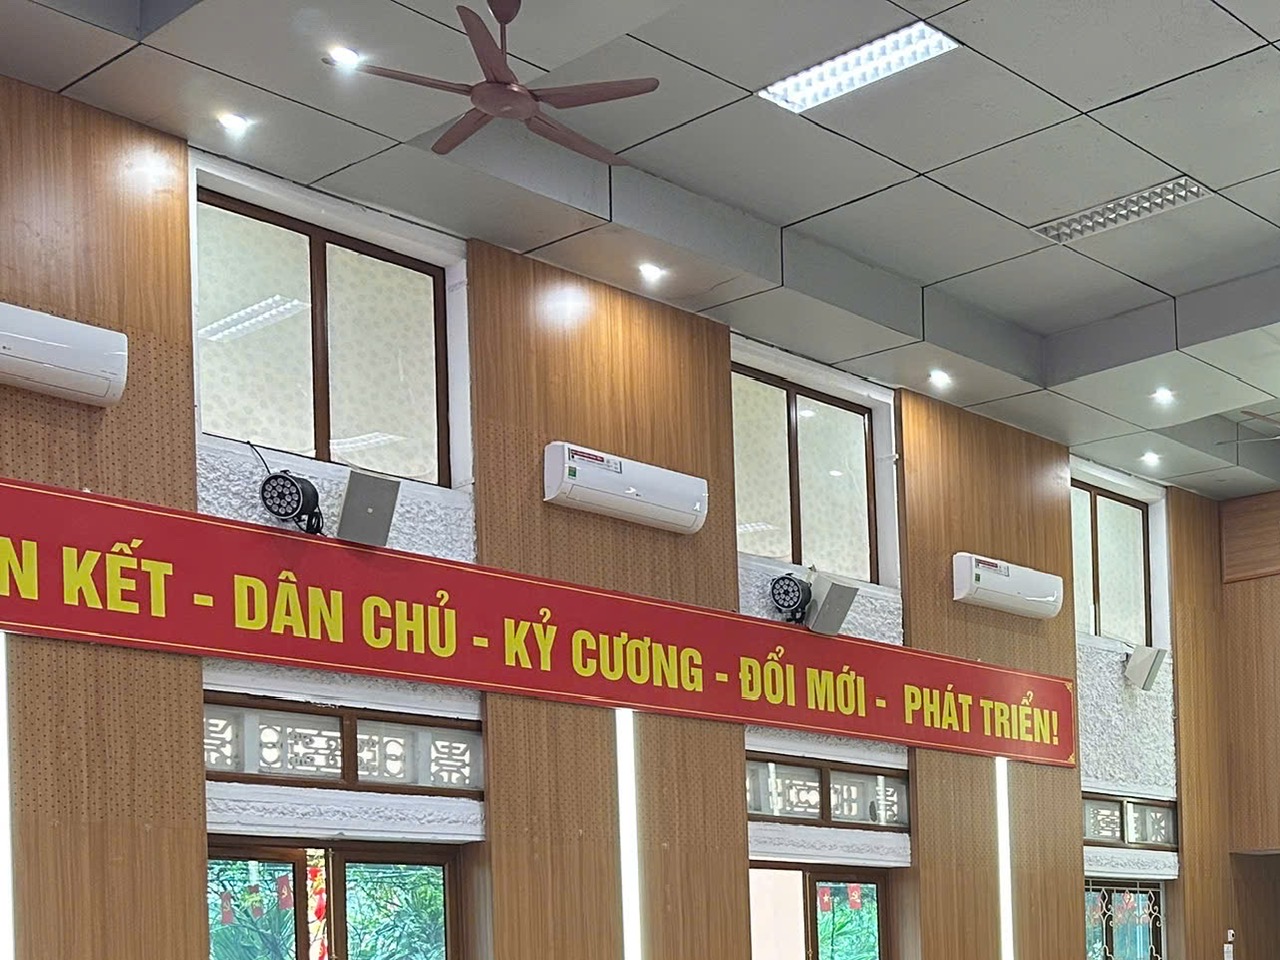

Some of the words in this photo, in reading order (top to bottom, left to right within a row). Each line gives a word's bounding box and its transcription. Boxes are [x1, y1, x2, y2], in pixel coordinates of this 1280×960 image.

[0, 535, 39, 600] N
[62, 538, 174, 618] KẾT
[193, 594, 214, 607] -
[233, 570, 344, 643] DÂN
[362, 590, 457, 658] CHỦ
[473, 636, 488, 648] -
[504, 608, 557, 671] KỶ
[572, 630, 704, 692] CƯƠNG
[716, 673, 728, 682] -
[739, 644, 796, 706] ĐỔI
[807, 667, 867, 716] MỚI
[904, 682, 972, 734] PHÁT
[981, 690, 1059, 746] TRIỂN!
